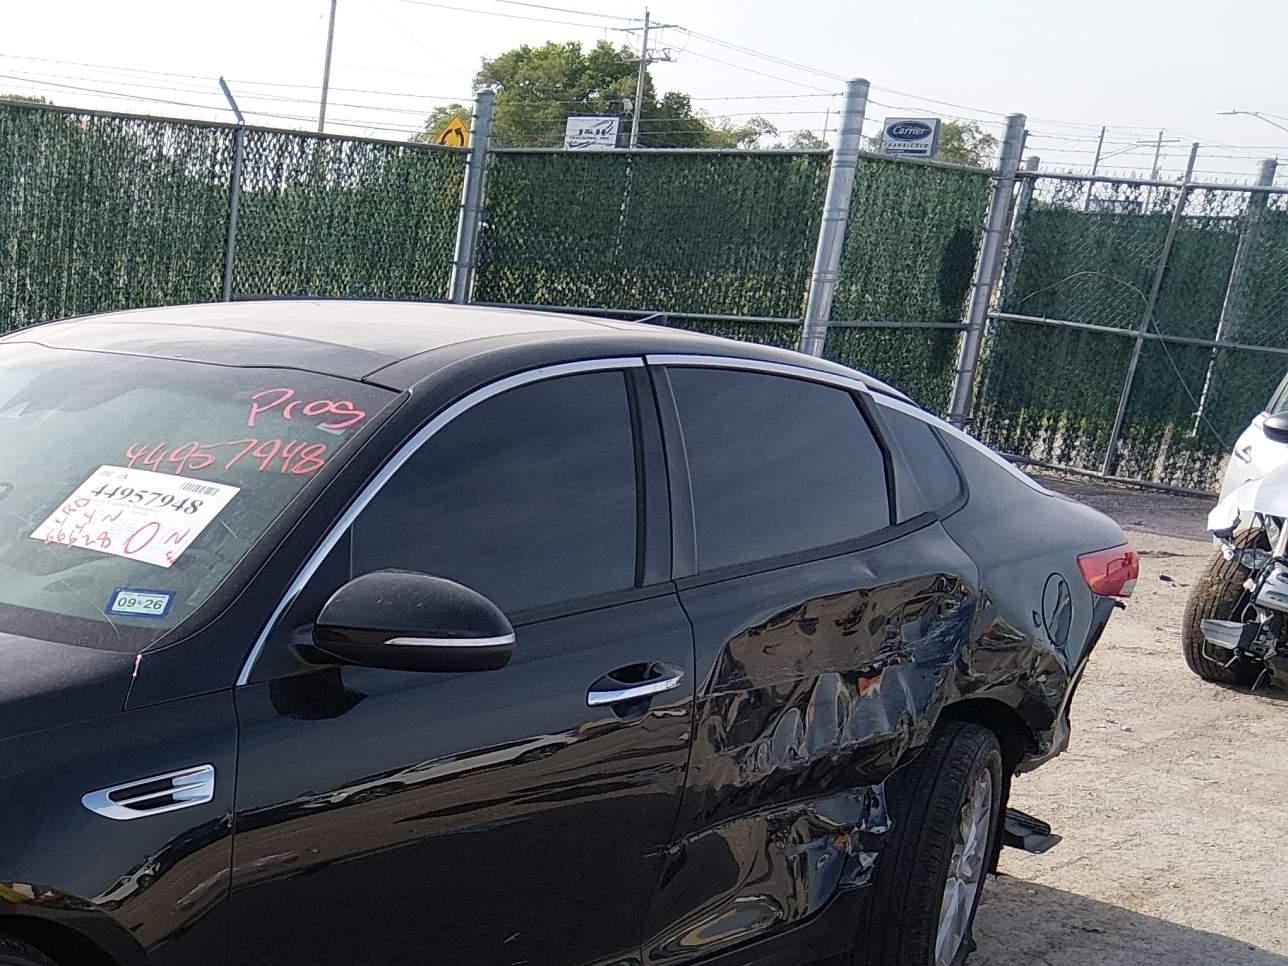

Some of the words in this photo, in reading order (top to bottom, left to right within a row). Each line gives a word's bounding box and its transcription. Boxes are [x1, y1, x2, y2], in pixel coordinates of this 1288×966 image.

[893, 125, 926, 135] Carrier
[125, 438, 328, 475] 44957948
[91, 484, 204, 515] 44957948
